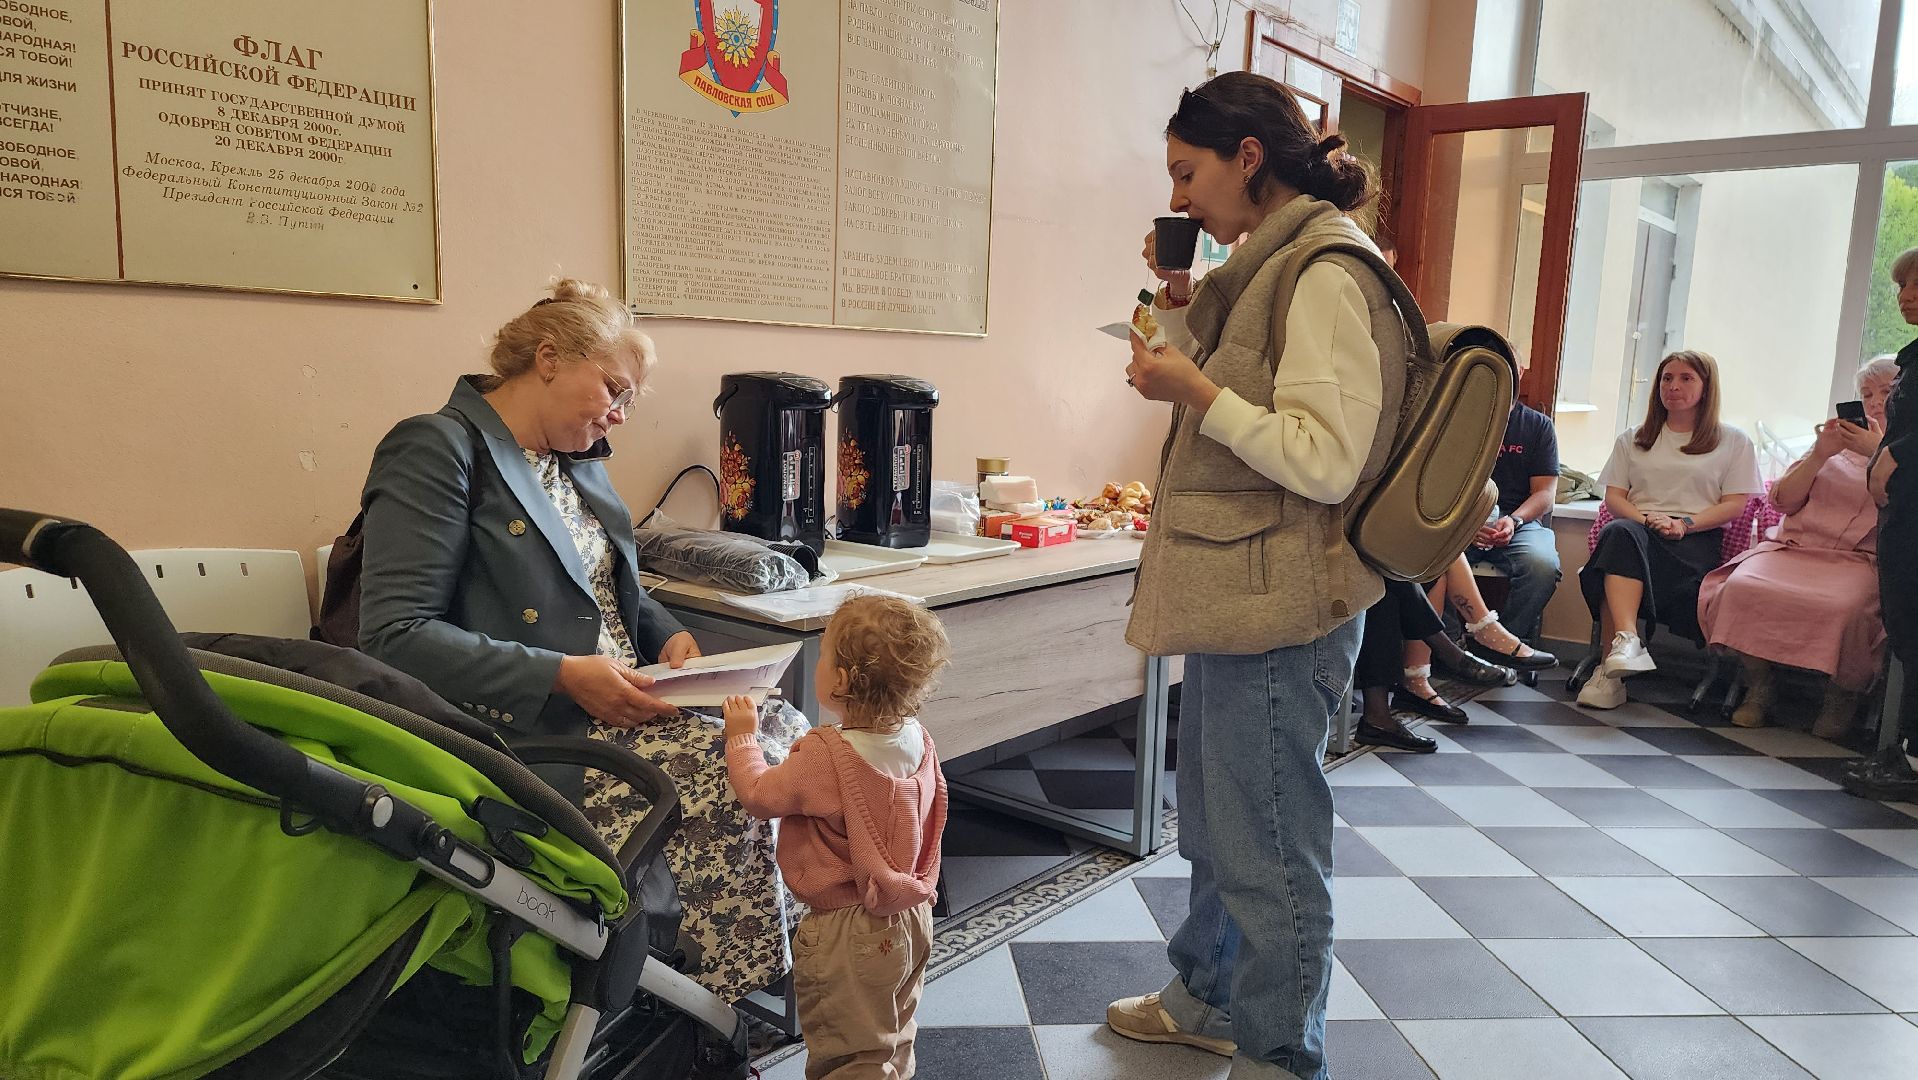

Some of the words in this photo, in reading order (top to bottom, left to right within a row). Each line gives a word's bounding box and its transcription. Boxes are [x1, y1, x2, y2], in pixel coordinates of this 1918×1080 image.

[0, 31, 76, 53] АРОДНАЯ!
[19, 49, 73, 68] ТОБОЙ!
[233, 34, 323, 70] ФЛАГ
[26, 75, 77, 92] ЖИЗНИ
[121, 41, 280, 86] РОССИЙСКОЙ
[287, 74, 417, 111] ФЕДЕРАЦИИ
[694, 75, 752, 108] ПАВЛОВСКАЯ
[756, 94, 775, 107] СОШ
[0, 103, 62, 122] ТЧИЗНЕ,
[139, 78, 206, 99] ПРИНЯТ
[211, 90, 354, 125] ГОСУДАРСТВЕННОЙ
[358, 117, 406, 133] ДУМОЙ
[217, 106, 225, 117] 8
[231, 108, 299, 129] ДЕКАБРЯ
[303, 121, 342, 136] 2000г.
[158, 112, 231, 132] ОДОБРЕН
[235, 124, 303, 144] СОВЕТОМ
[307, 135, 393, 158] ФЕДЕРАЦИИ
[215, 135, 231, 147] 20
[235, 138, 304, 157] ДЕКАБРЯ
[122, 165, 222, 188] Федеральный
[228, 178, 357, 205] Конституционный
[361, 196, 398, 211] Закон
[144, 151, 205, 171] Москва,
[210, 160, 263, 178] Кремль
[268, 168, 284, 181] 25
[289, 171, 341, 189] декабря
[381, 186, 406, 198] года
[162, 186, 243, 207] Президент
[328, 206, 395, 224] Федерации
[1508, 445, 1523, 454] FC
[517, 886, 556, 922] book
